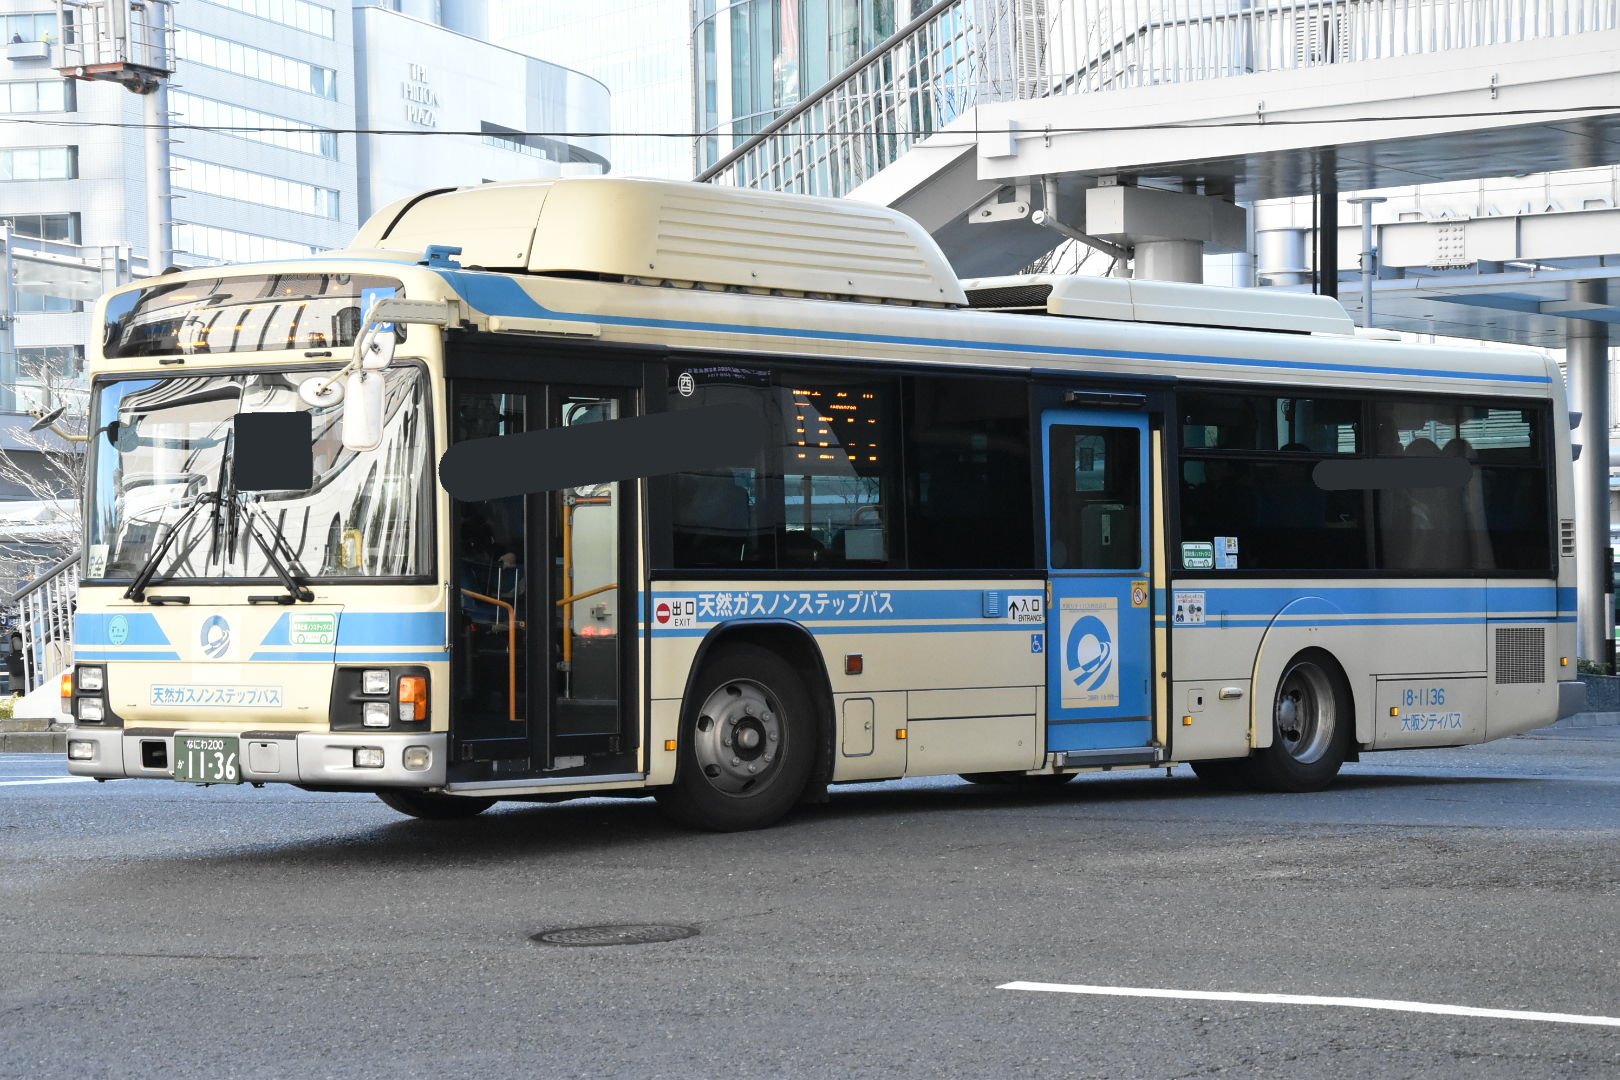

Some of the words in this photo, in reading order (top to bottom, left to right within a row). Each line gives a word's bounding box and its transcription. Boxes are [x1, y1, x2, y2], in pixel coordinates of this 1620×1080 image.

[401, 81, 440, 109] HILTON
[406, 103, 437, 128] PLAZA
[672, 601, 694, 616] 出口
[698, 591, 894, 617] 天然ガスノンステップバス
[1021, 599, 1040, 612] 入口
[674, 618, 690, 627] EXIT
[1019, 614, 1042, 622] ENTRANCE
[153, 687, 280, 704] 天然ガスノンステップバス
[1401, 713, 1462, 731] 大阪シティバス
